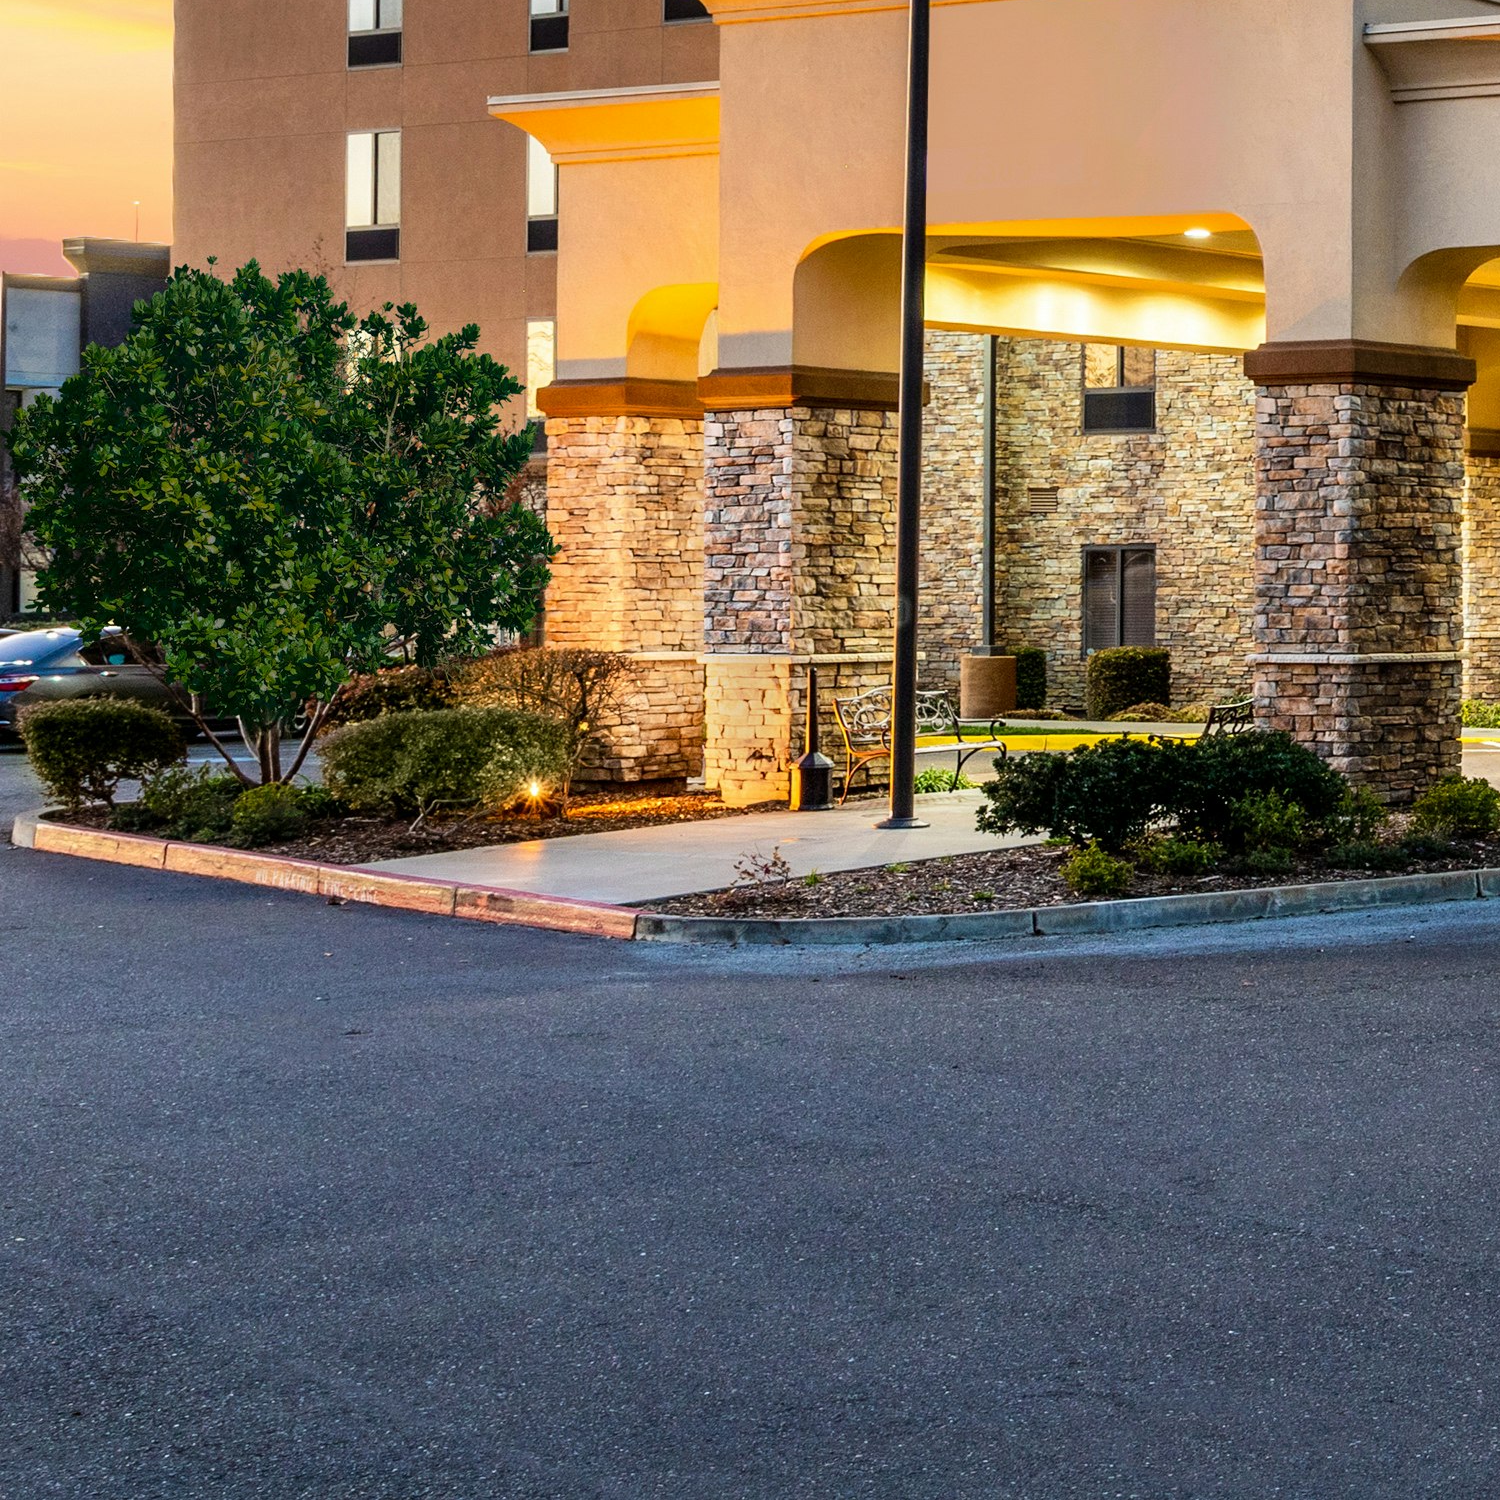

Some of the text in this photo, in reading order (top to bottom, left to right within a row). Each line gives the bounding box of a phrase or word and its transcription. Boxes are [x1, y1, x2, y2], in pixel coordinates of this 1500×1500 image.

[255, 868, 267, 883] NO
[272, 869, 313, 892] PARKING
[353, 886, 380, 904] LANE
